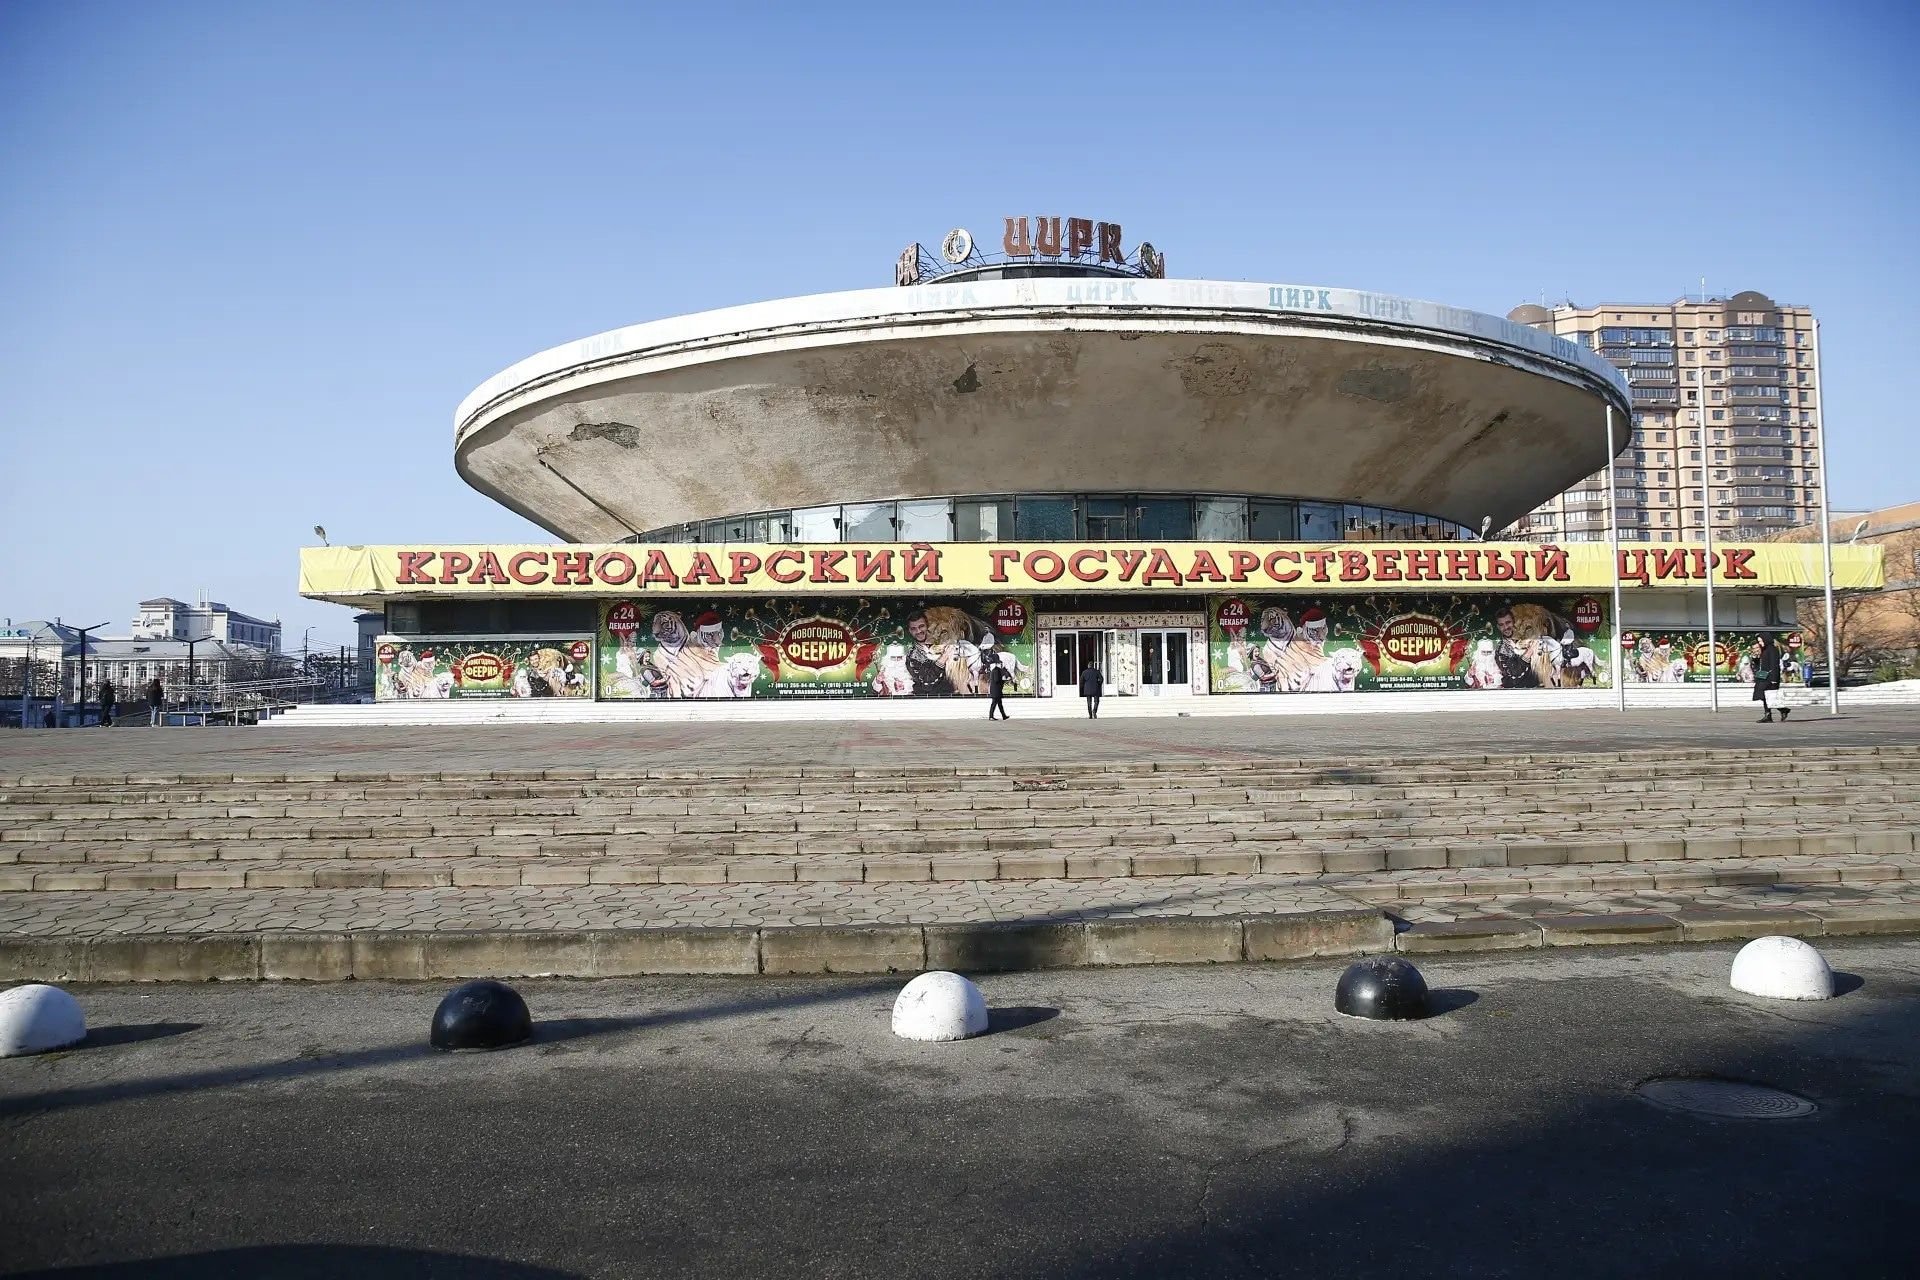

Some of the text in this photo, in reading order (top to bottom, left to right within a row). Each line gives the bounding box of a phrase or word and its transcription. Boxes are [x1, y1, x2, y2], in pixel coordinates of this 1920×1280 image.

[1003, 215, 1126, 265] ЦИРК
[1268, 287, 1332, 311] ЦИРК
[1359, 295, 1414, 322] ЦИРК
[1551, 337, 1580, 363] ЦИРК
[396, 543, 1757, 588] КРАСНОДАРСКИЙ ГОСУДАРСТВЕННЫЙ ЦИРК
[620, 607, 635, 620] 24
[1007, 604, 1022, 617] 15
[1230, 603, 1244, 616] 24
[1585, 602, 1598, 614] 15
[609, 622, 640, 630] ДЕКАБРЯ
[997, 619, 1024, 627] ЯНВАРЯ
[1219, 618, 1249, 627] ДЕКАБРЯ
[1576, 616, 1600, 624] ЯНВАРЯ
[791, 627, 843, 640] НОВОГОДНЯЯ
[1391, 623, 1438, 636] НОВОГОДНЯЯ
[788, 641, 847, 661] ФЕЕРИЯ
[1387, 637, 1442, 656] ФЕЕРИЯ
[1696, 653, 1725, 664] ФЕИЯ
[465, 666, 498, 678] ФЕЕРИЯ
